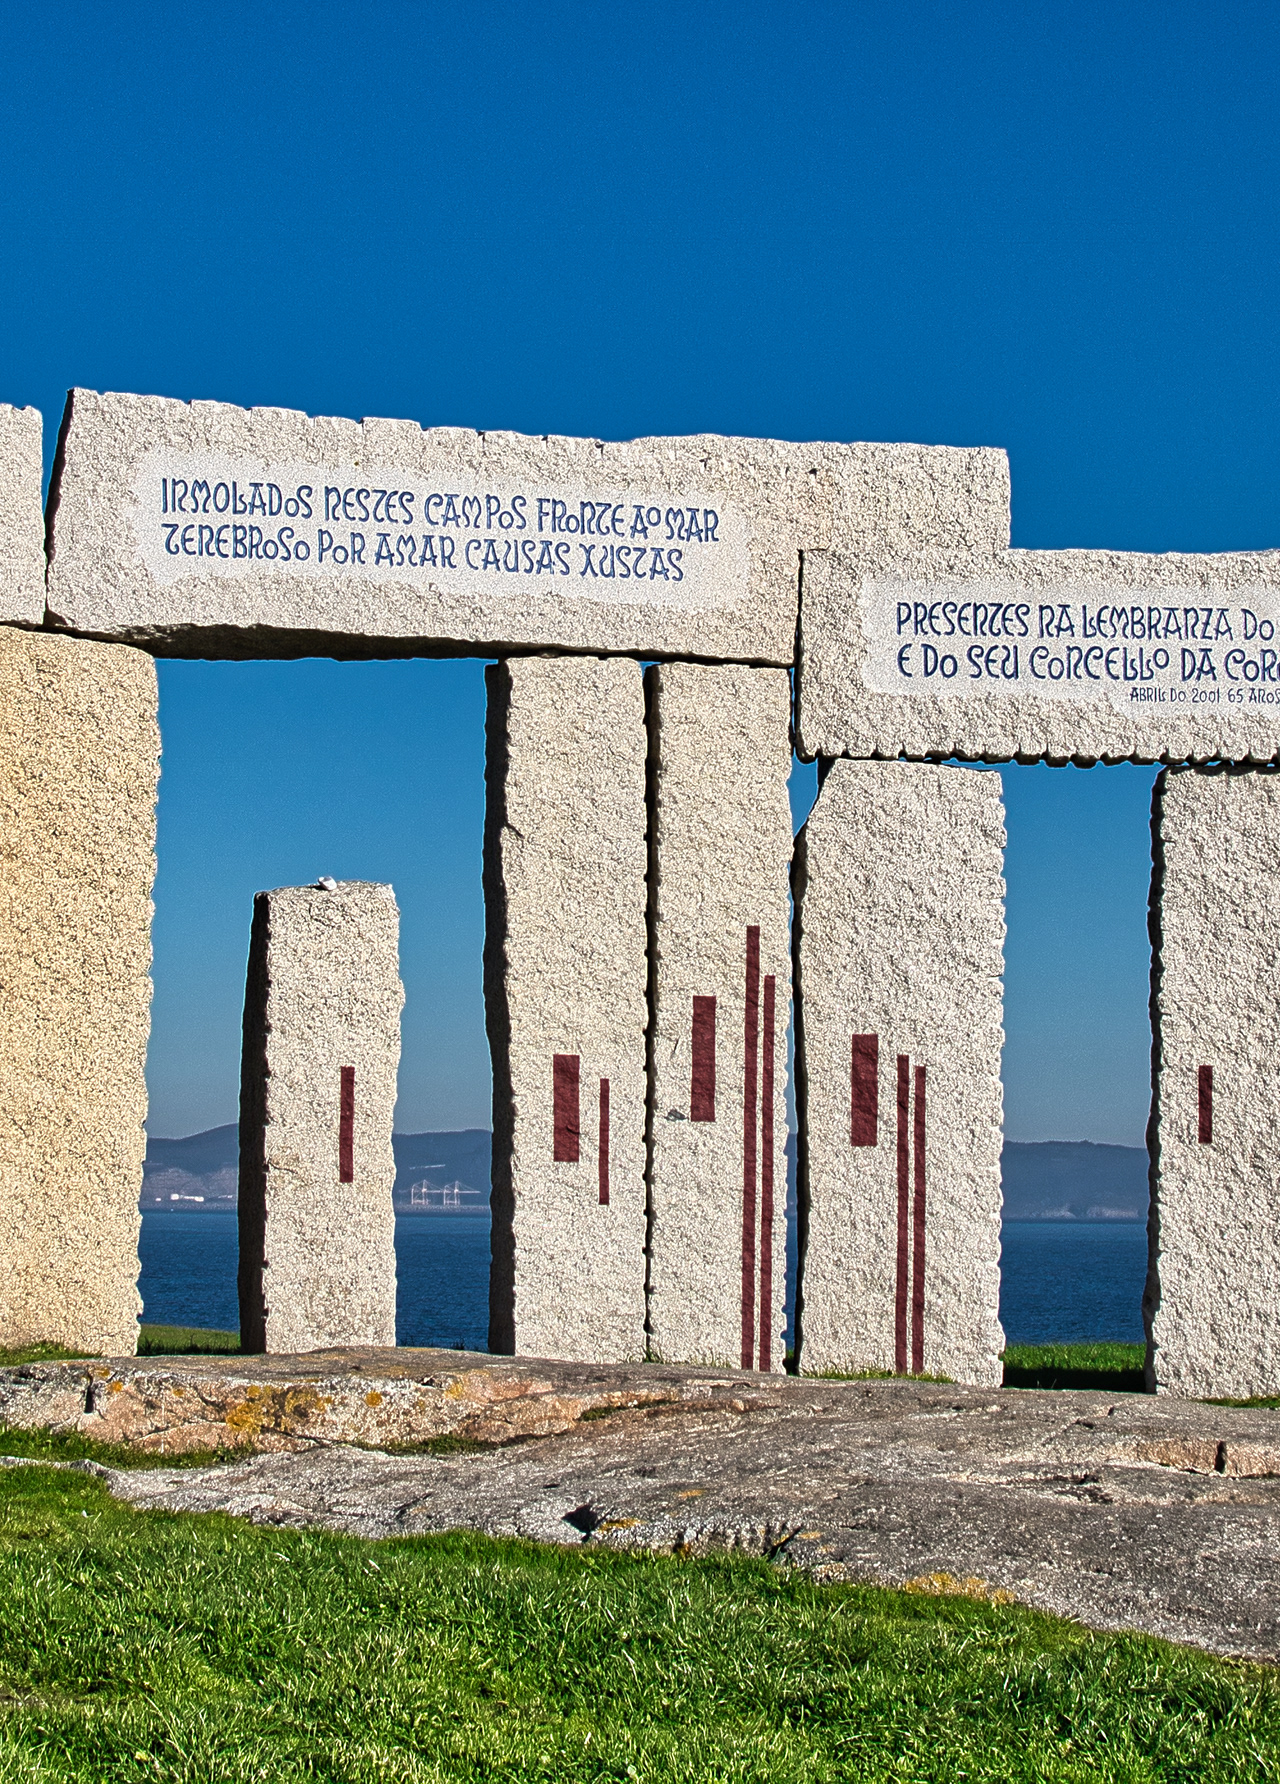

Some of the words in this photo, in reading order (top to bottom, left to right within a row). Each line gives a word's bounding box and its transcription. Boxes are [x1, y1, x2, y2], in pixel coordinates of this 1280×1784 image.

[162, 478, 312, 519] INMOLADOS
[325, 486, 414, 525] NESTES
[425, 493, 526, 530] CAMPOS
[536, 498, 625, 536] FRONTE
[630, 505, 662, 539] AO
[665, 507, 719, 542] MAR
[161, 523, 310, 561] TENEBROSO
[318, 529, 365, 564] POR
[375, 533, 457, 569] AMAR
[465, 539, 570, 576] CAUSAS
[579, 543, 684, 581] XUSTAS
[897, 602, 1030, 637] PRESENTES
[1039, 604, 1075, 639] NA
[1082, 605, 1233, 641] LEMBRANZA
[1241, 608, 1274, 641] DO
[897, 643, 913, 678] E
[921, 643, 958, 679] DO
[967, 644, 1019, 680] SEU
[1028, 645, 1170, 681] CONCELLO
[1181, 647, 1217, 682] DA
[1130, 687, 1166, 703] ABRIL
[1170, 687, 1187, 703] DO
[1191, 687, 1220, 704] 2001
[1227, 688, 1244, 703] 65
